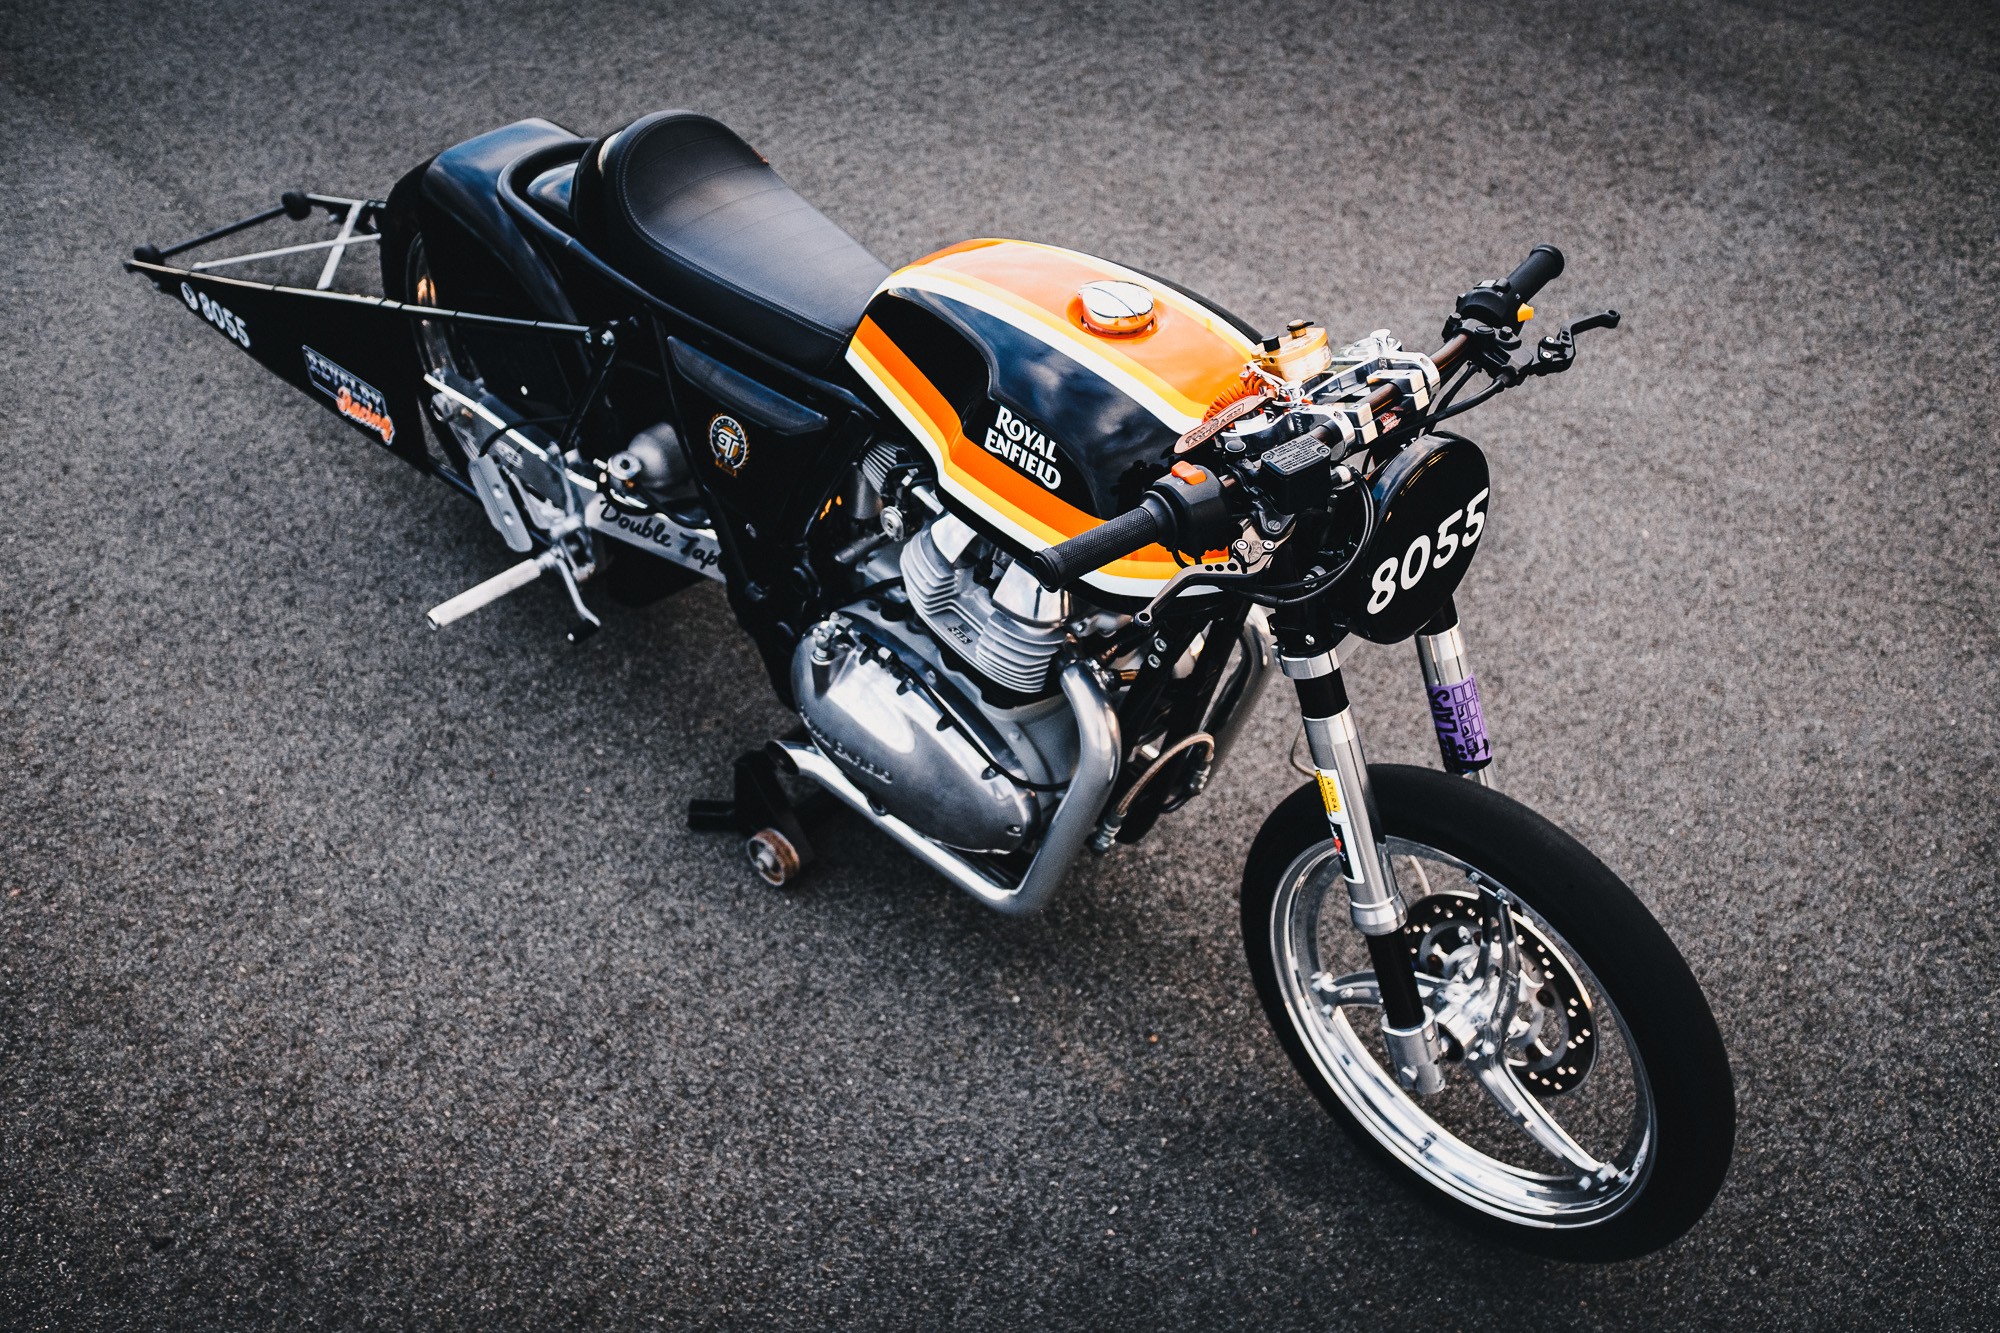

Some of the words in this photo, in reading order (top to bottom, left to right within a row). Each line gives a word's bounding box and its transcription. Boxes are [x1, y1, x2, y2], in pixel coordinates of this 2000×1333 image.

[198, 291, 251, 349] 8055
[984, 427, 1062, 490] ENFIELD
[994, 405, 1057, 463] ROYAL
[600, 500, 672, 548] Double
[679, 531, 718, 570] Tap
[1366, 486, 1489, 615] 8055
